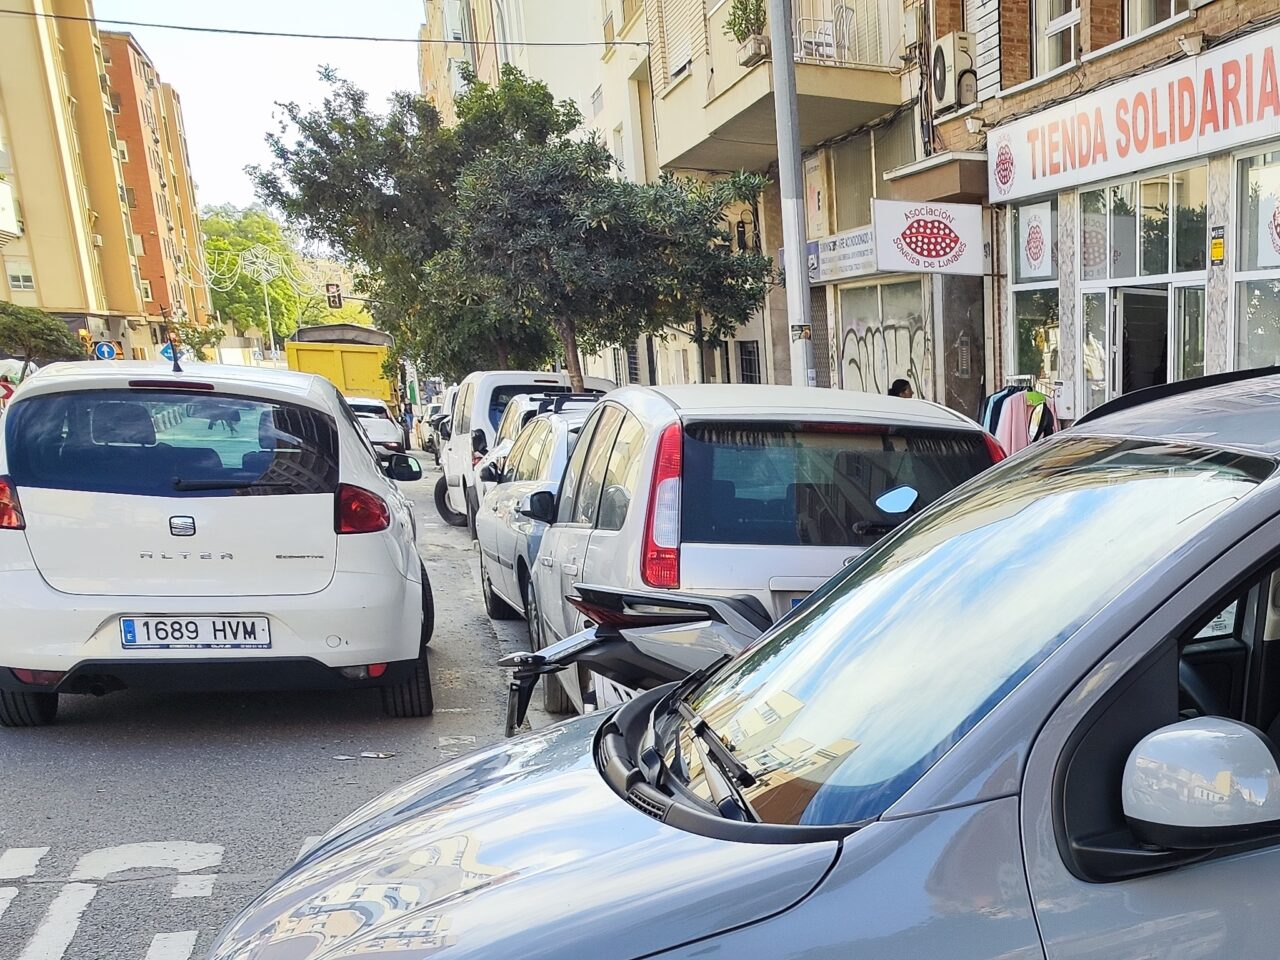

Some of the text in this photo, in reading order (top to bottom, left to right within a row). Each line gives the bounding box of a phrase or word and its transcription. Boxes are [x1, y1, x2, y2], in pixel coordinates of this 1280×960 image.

[1027, 106, 1108, 180] TIENDA
[1116, 46, 1280, 159] SOLIDARIA
[142, 621, 257, 641] 1689 HVM
